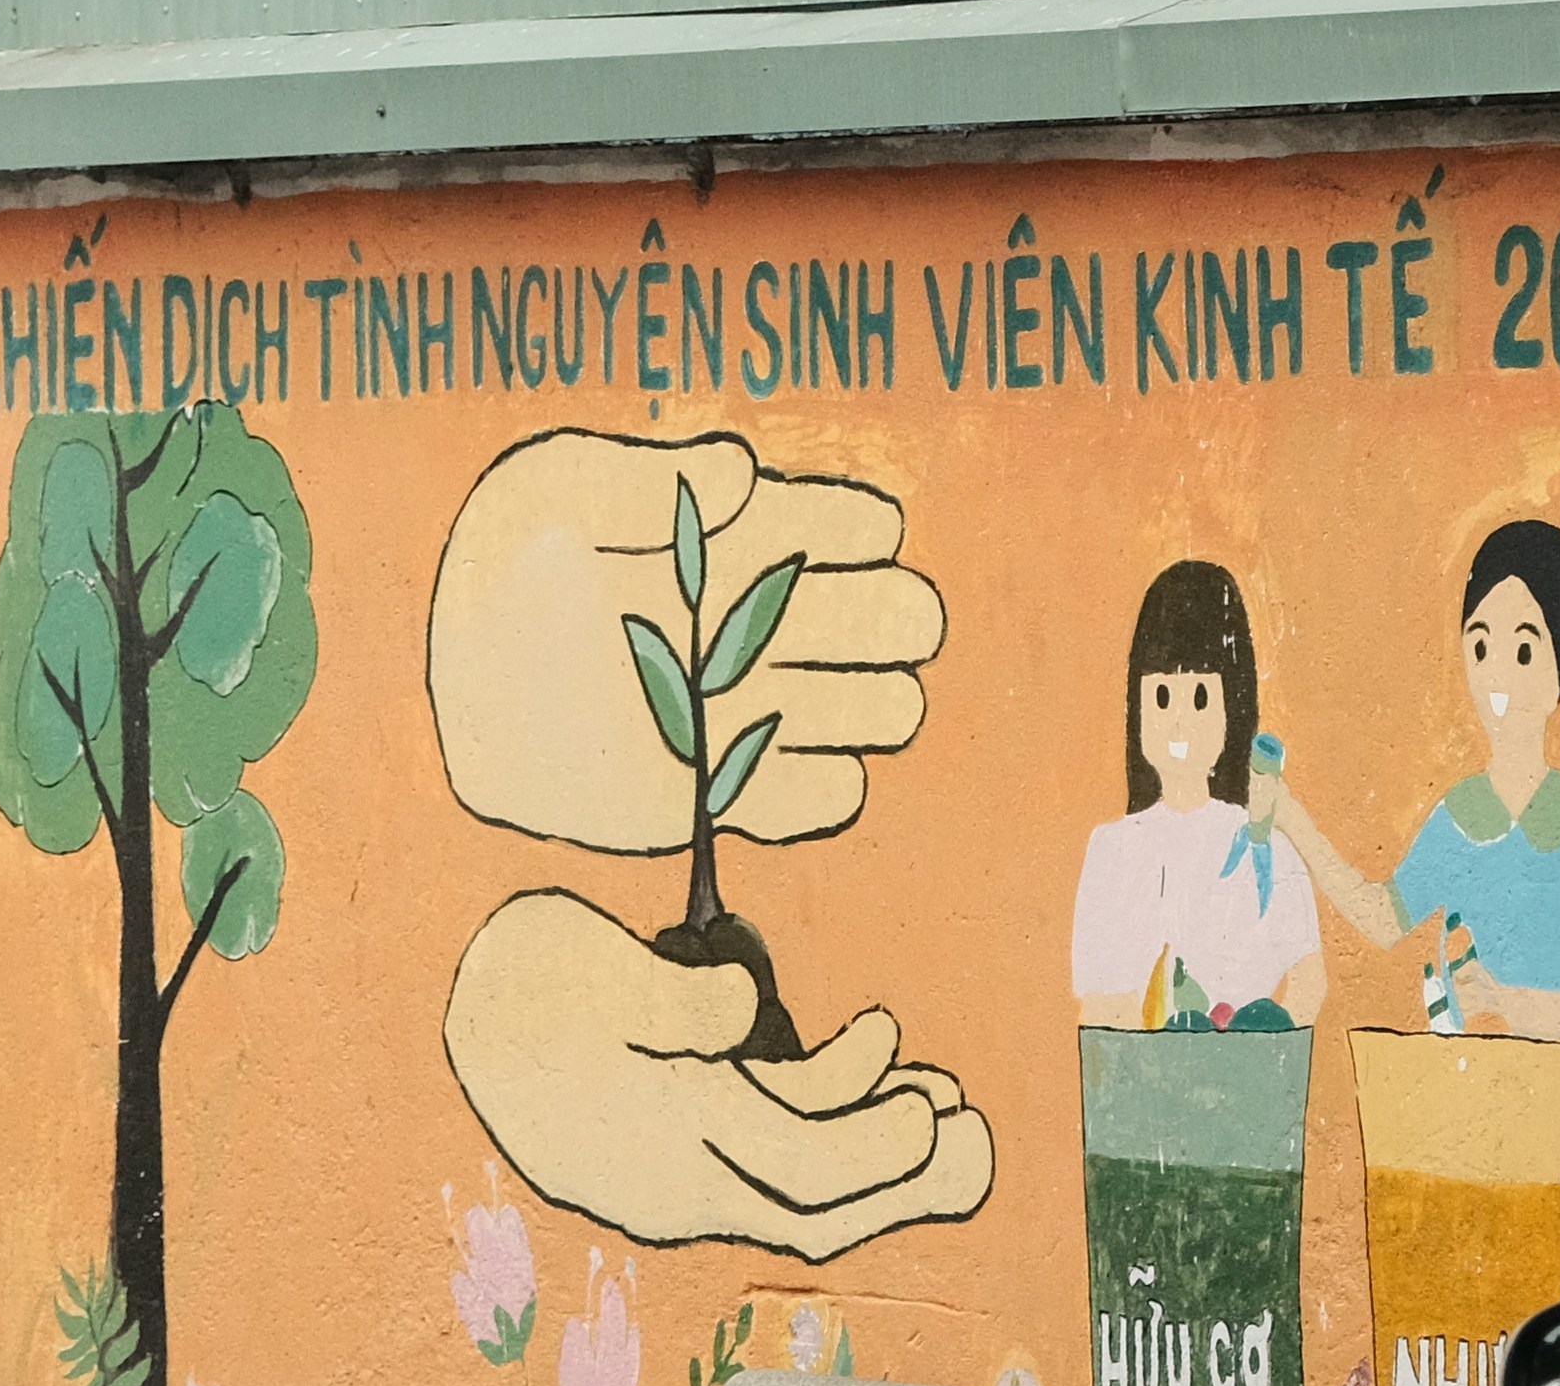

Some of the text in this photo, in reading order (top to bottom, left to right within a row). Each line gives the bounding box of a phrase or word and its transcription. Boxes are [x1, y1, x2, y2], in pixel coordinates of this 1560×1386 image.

[304, 239, 455, 403] TÌNH
[470, 218, 725, 420] NGUYỆN
[740, 258, 895, 401] SINH
[923, 213, 1106, 392] VIÊN
[1135, 245, 1304, 395] KINH
[1326, 163, 1446, 376] TẾ
